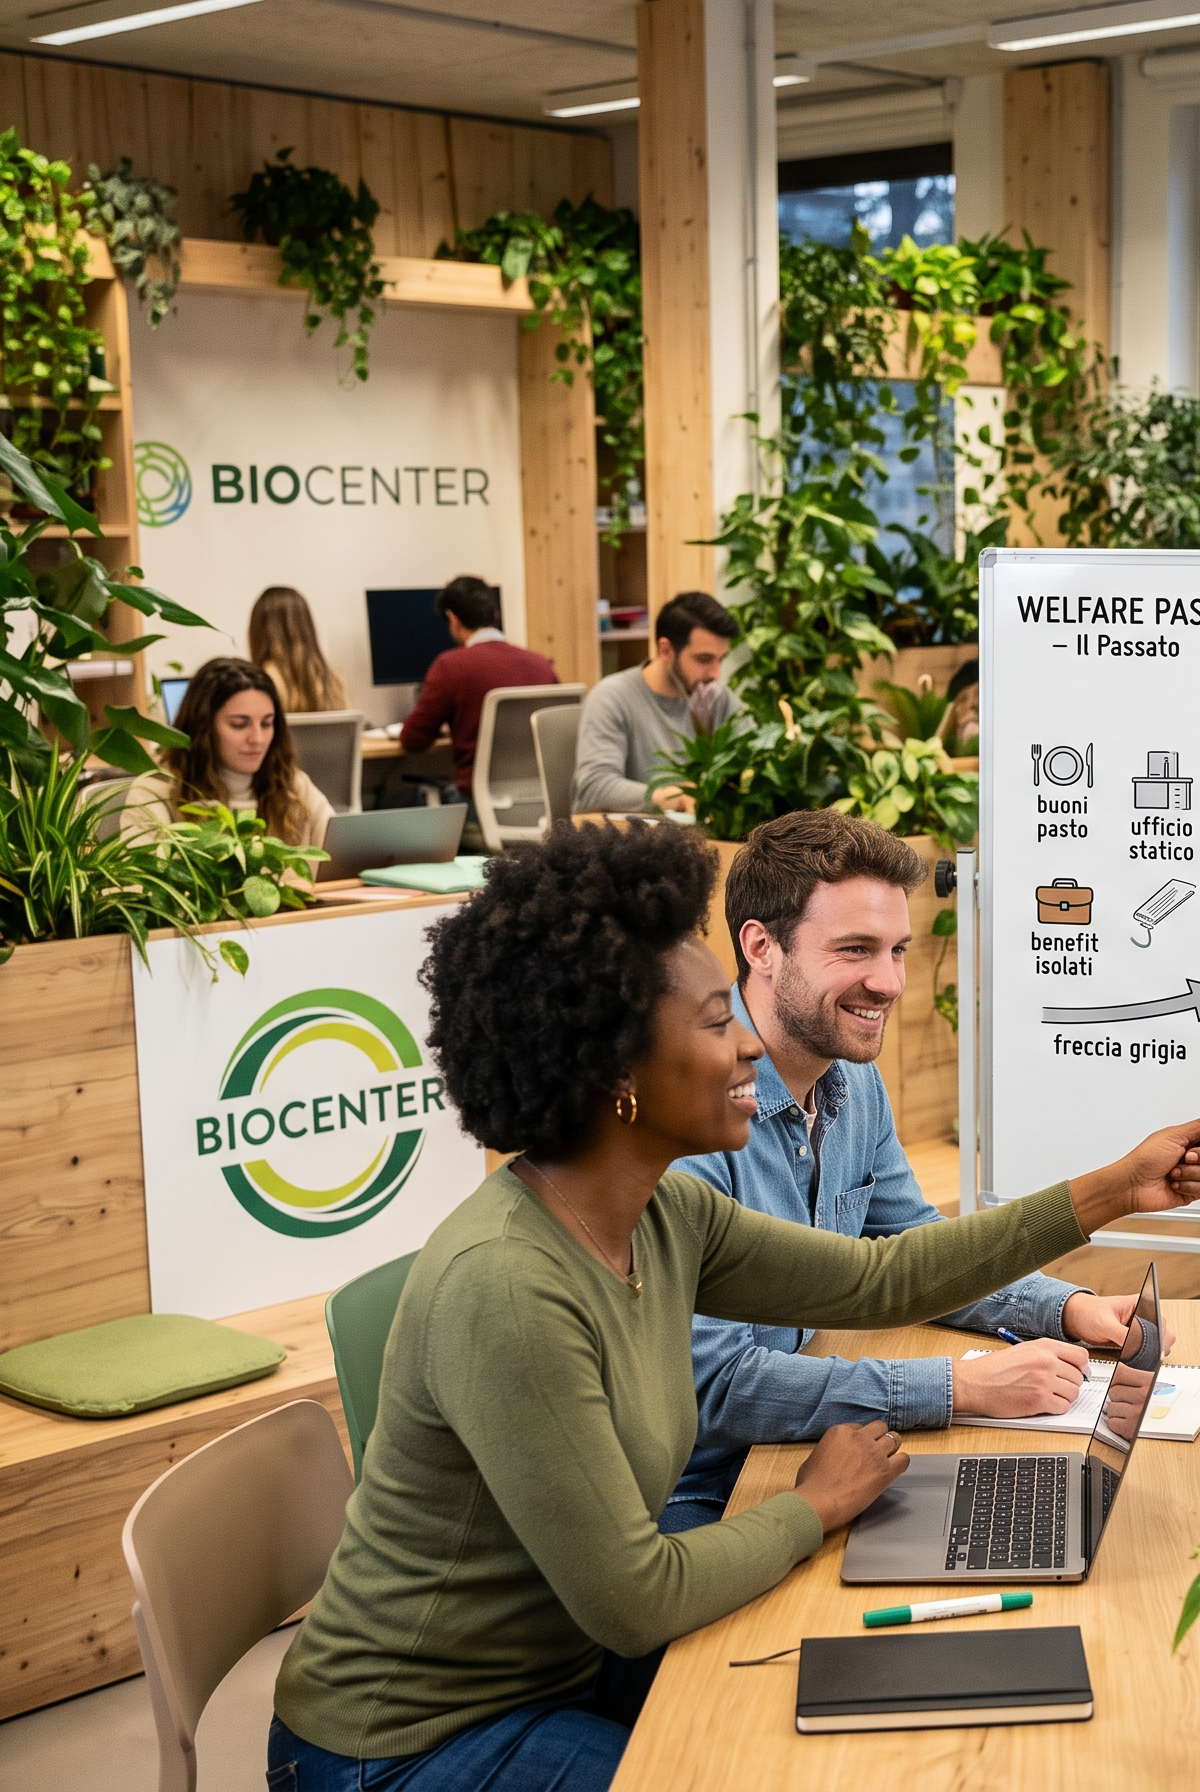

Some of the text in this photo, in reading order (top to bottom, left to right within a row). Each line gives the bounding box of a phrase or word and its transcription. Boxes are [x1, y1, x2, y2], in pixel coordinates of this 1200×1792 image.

[211, 464, 489, 506] BIOCENTER
[1017, 595, 1144, 625] WELFARE
[1077, 633, 1089, 656] Il
[1097, 634, 1180, 658] Passato
[1037, 794, 1088, 815] buoni
[1037, 819, 1088, 843] pasto
[1131, 815, 1193, 837] ufficio
[1129, 839, 1194, 861] statico
[1031, 931, 1099, 953] benefit
[1036, 955, 1093, 976] isolati
[1053, 1033, 1186, 1065] freccia grigia
[196, 1076, 446, 1157] BIOCENTER
